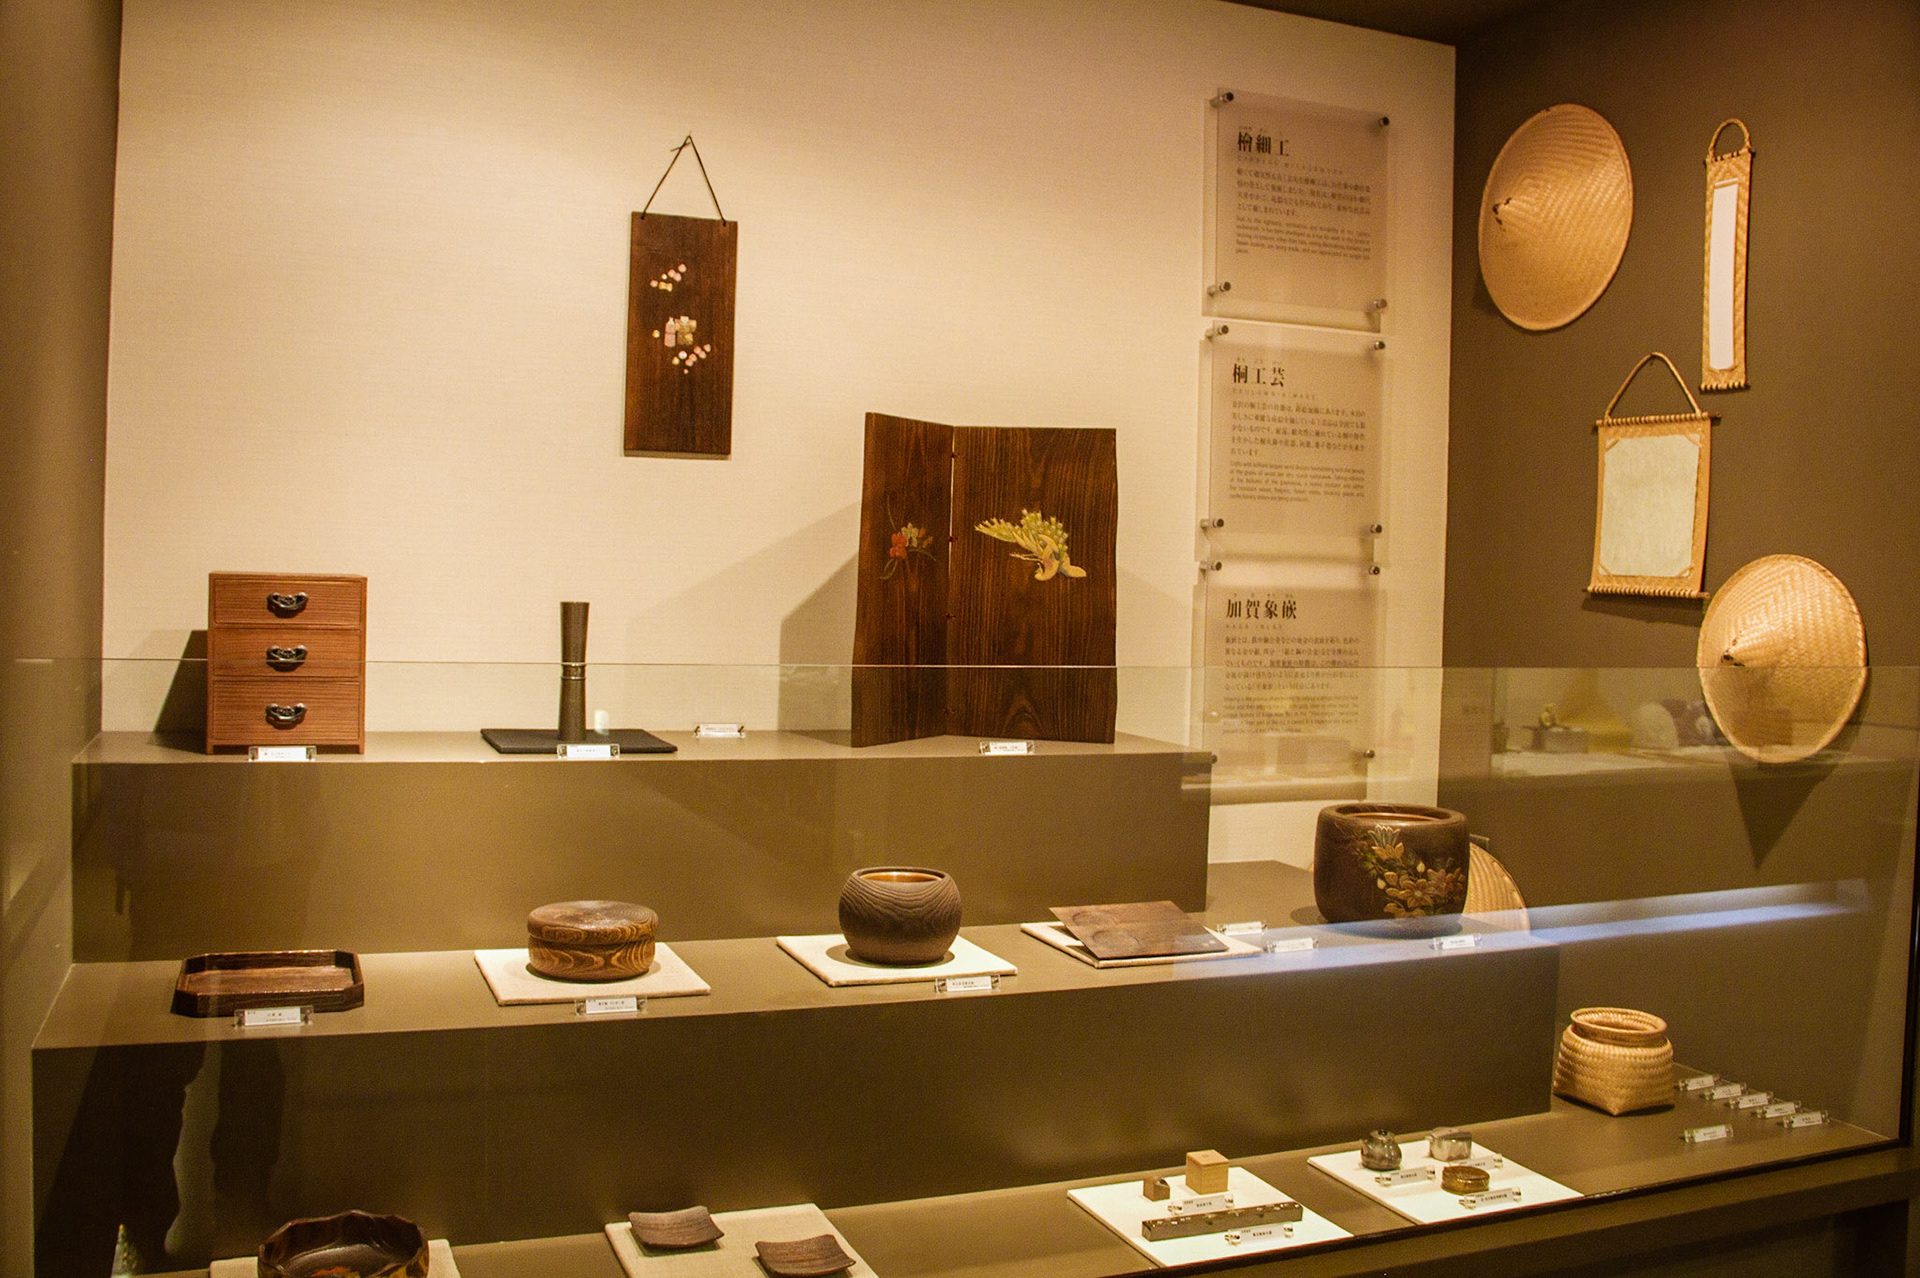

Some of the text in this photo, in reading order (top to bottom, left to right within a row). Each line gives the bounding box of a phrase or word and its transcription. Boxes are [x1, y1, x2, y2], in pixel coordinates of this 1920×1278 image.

[1233, 363, 1285, 387] 桐工芸
[1226, 599, 1297, 619] 加賀象嵌
